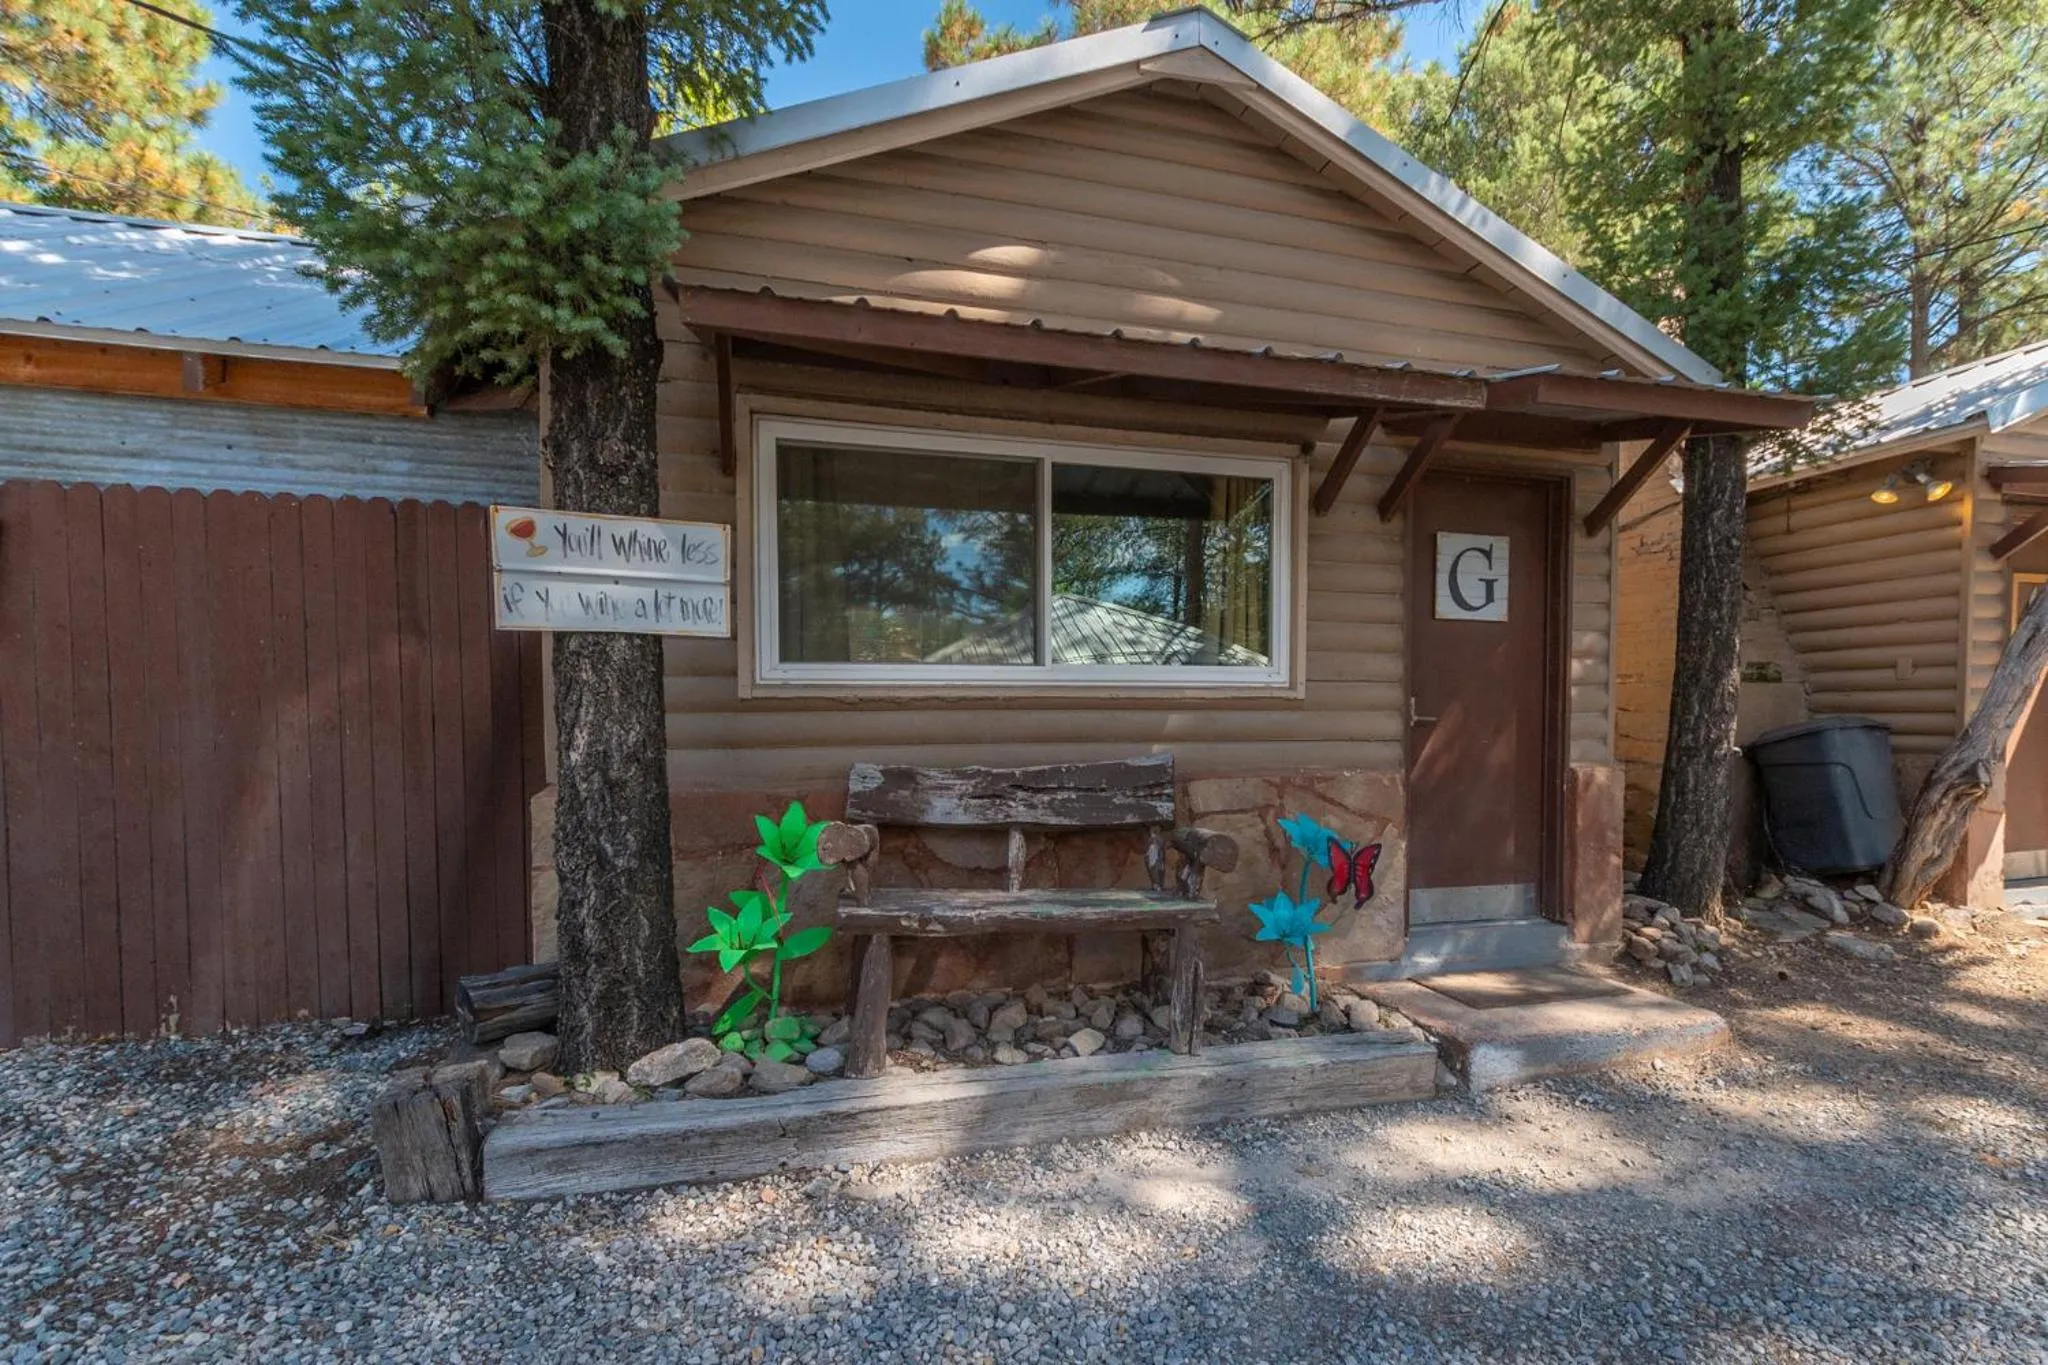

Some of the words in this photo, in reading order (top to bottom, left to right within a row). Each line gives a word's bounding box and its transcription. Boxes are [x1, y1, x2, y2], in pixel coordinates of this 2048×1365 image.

[611, 528, 670, 564] Whine
[681, 533, 719, 565] less
[1448, 542, 1499, 612] G
[634, 598, 648, 620] a
